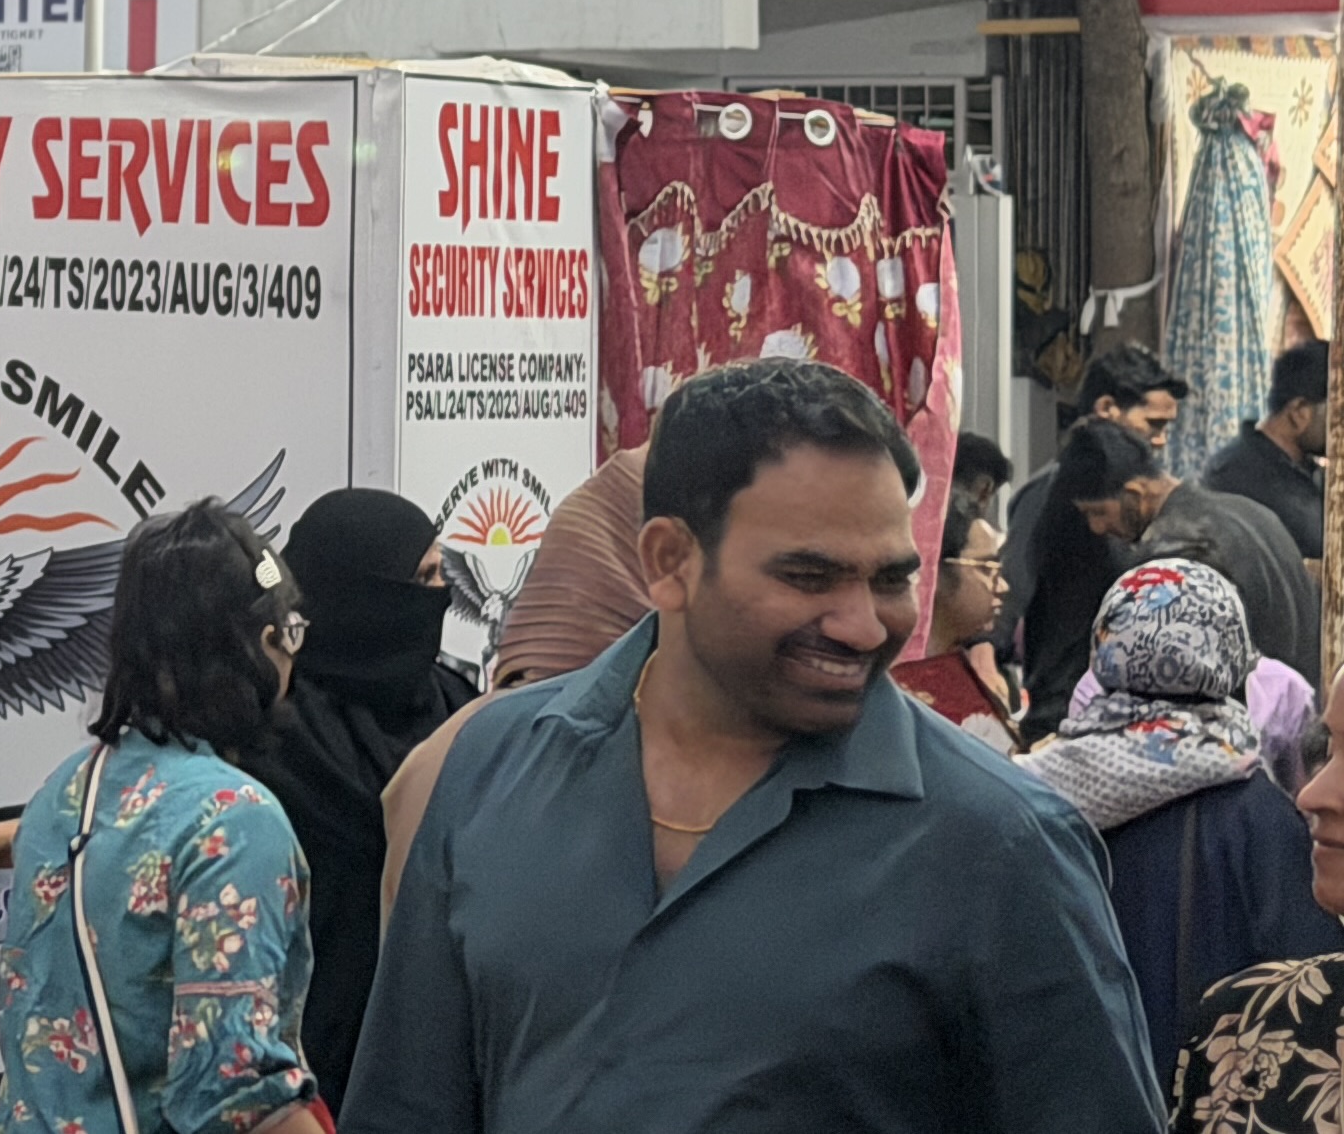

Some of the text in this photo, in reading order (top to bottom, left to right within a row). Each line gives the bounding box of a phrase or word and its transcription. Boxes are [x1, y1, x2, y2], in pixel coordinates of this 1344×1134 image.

[0, 29, 44, 40] TICKET
[32, 117, 331, 237] SERVICES
[437, 101, 562, 235] SHINE
[408, 242, 589, 319] SECURITY SERVICES
[406, 389, 587, 421] PSA/L/24/TS/2023/AUG/3/409
[407, 352, 586, 383] PSARA LICENSE COMPANY:
[0, 358, 168, 518] SMILE
[435, 465, 479, 533] SERVE
[481, 457, 519, 481] WITH
